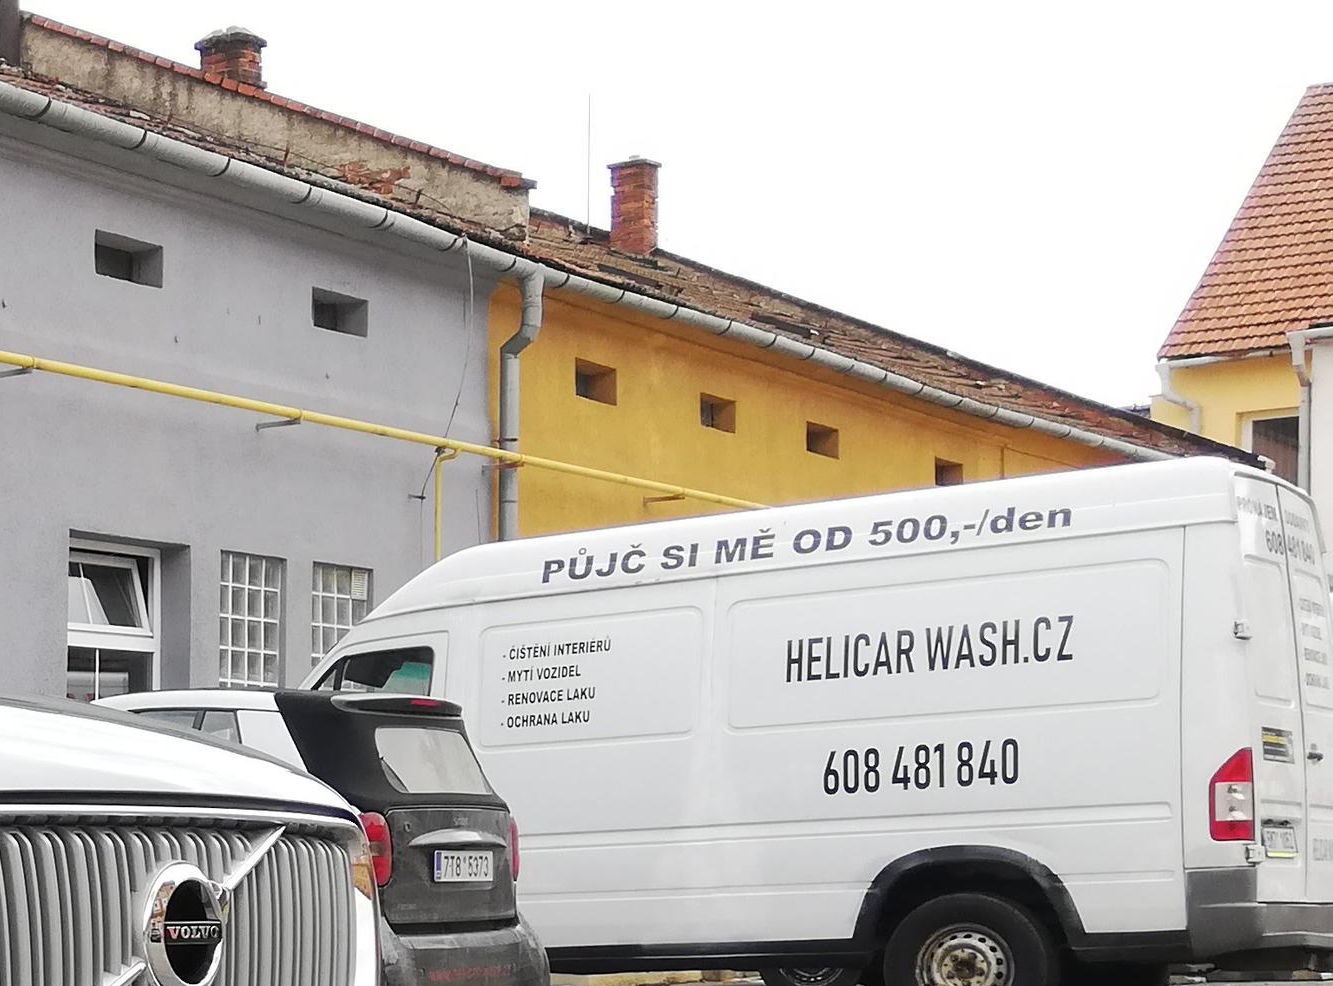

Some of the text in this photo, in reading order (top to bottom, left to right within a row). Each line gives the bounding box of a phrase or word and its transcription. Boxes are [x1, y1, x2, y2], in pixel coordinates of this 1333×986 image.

[541, 506, 1073, 584] PŮJČ SI MĚ OD 500,-/den
[786, 615, 1074, 683] HELICAR WASH.CZ
[507, 665, 581, 682] MYTÍ VOZIDEL
[507, 687, 596, 706] RENOVACE LAKU
[507, 710, 590, 728] OCHRANA LAKU
[823, 738, 1019, 795] 608 481 840
[444, 855, 462, 878] 7T8
[166, 925, 220, 940] VOLVO
